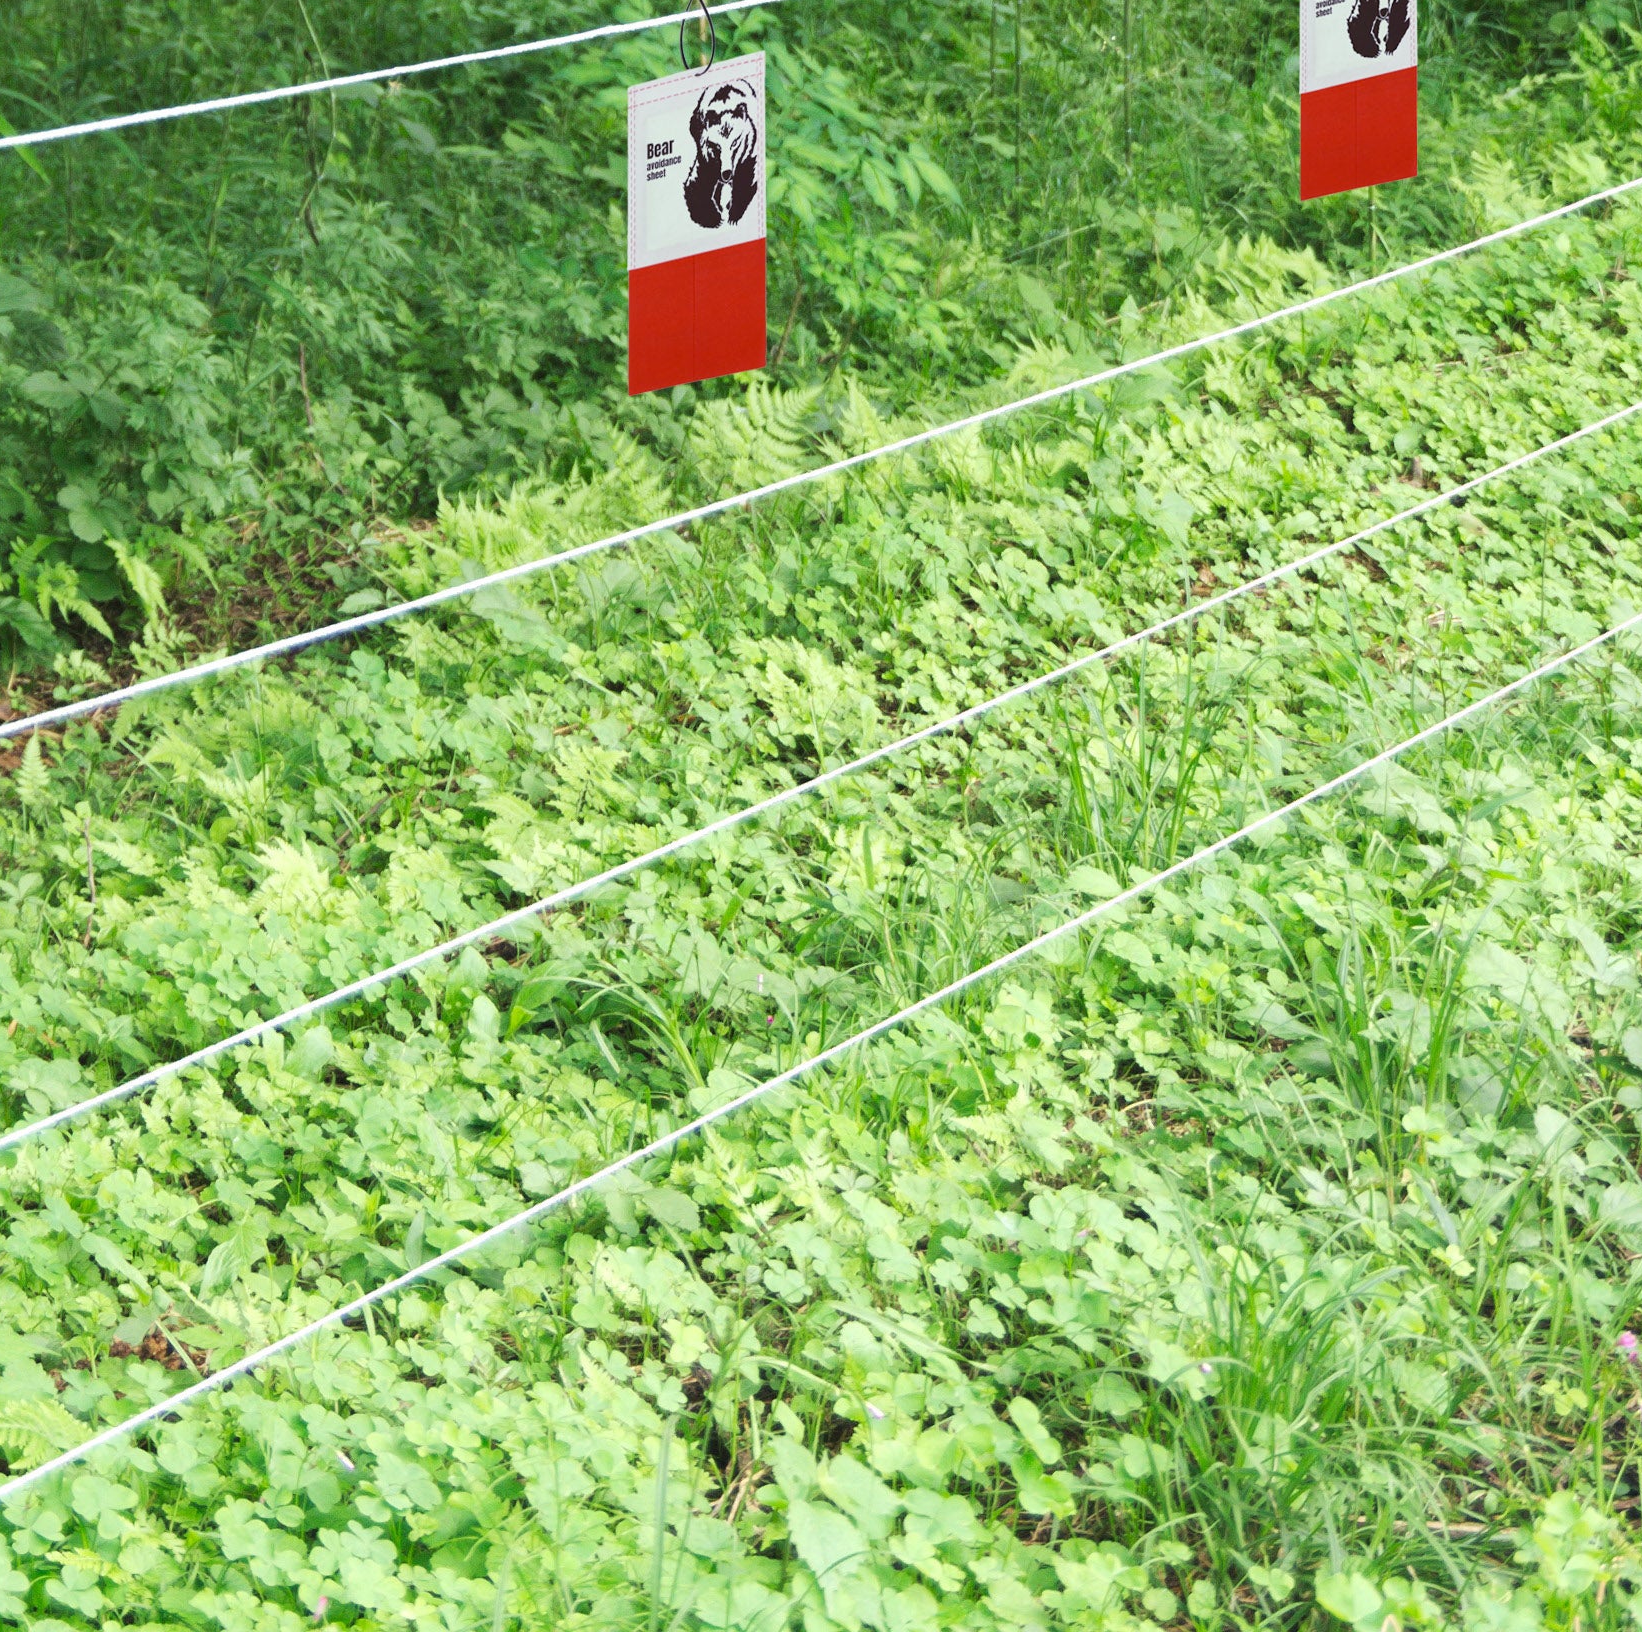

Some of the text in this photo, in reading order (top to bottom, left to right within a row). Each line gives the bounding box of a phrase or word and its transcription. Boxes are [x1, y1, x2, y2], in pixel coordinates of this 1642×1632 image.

[1315, 7, 1333, 18] sheet
[646, 139, 674, 159] Bear
[646, 155, 681, 171] avoidance
[646, 169, 667, 181] sheet
